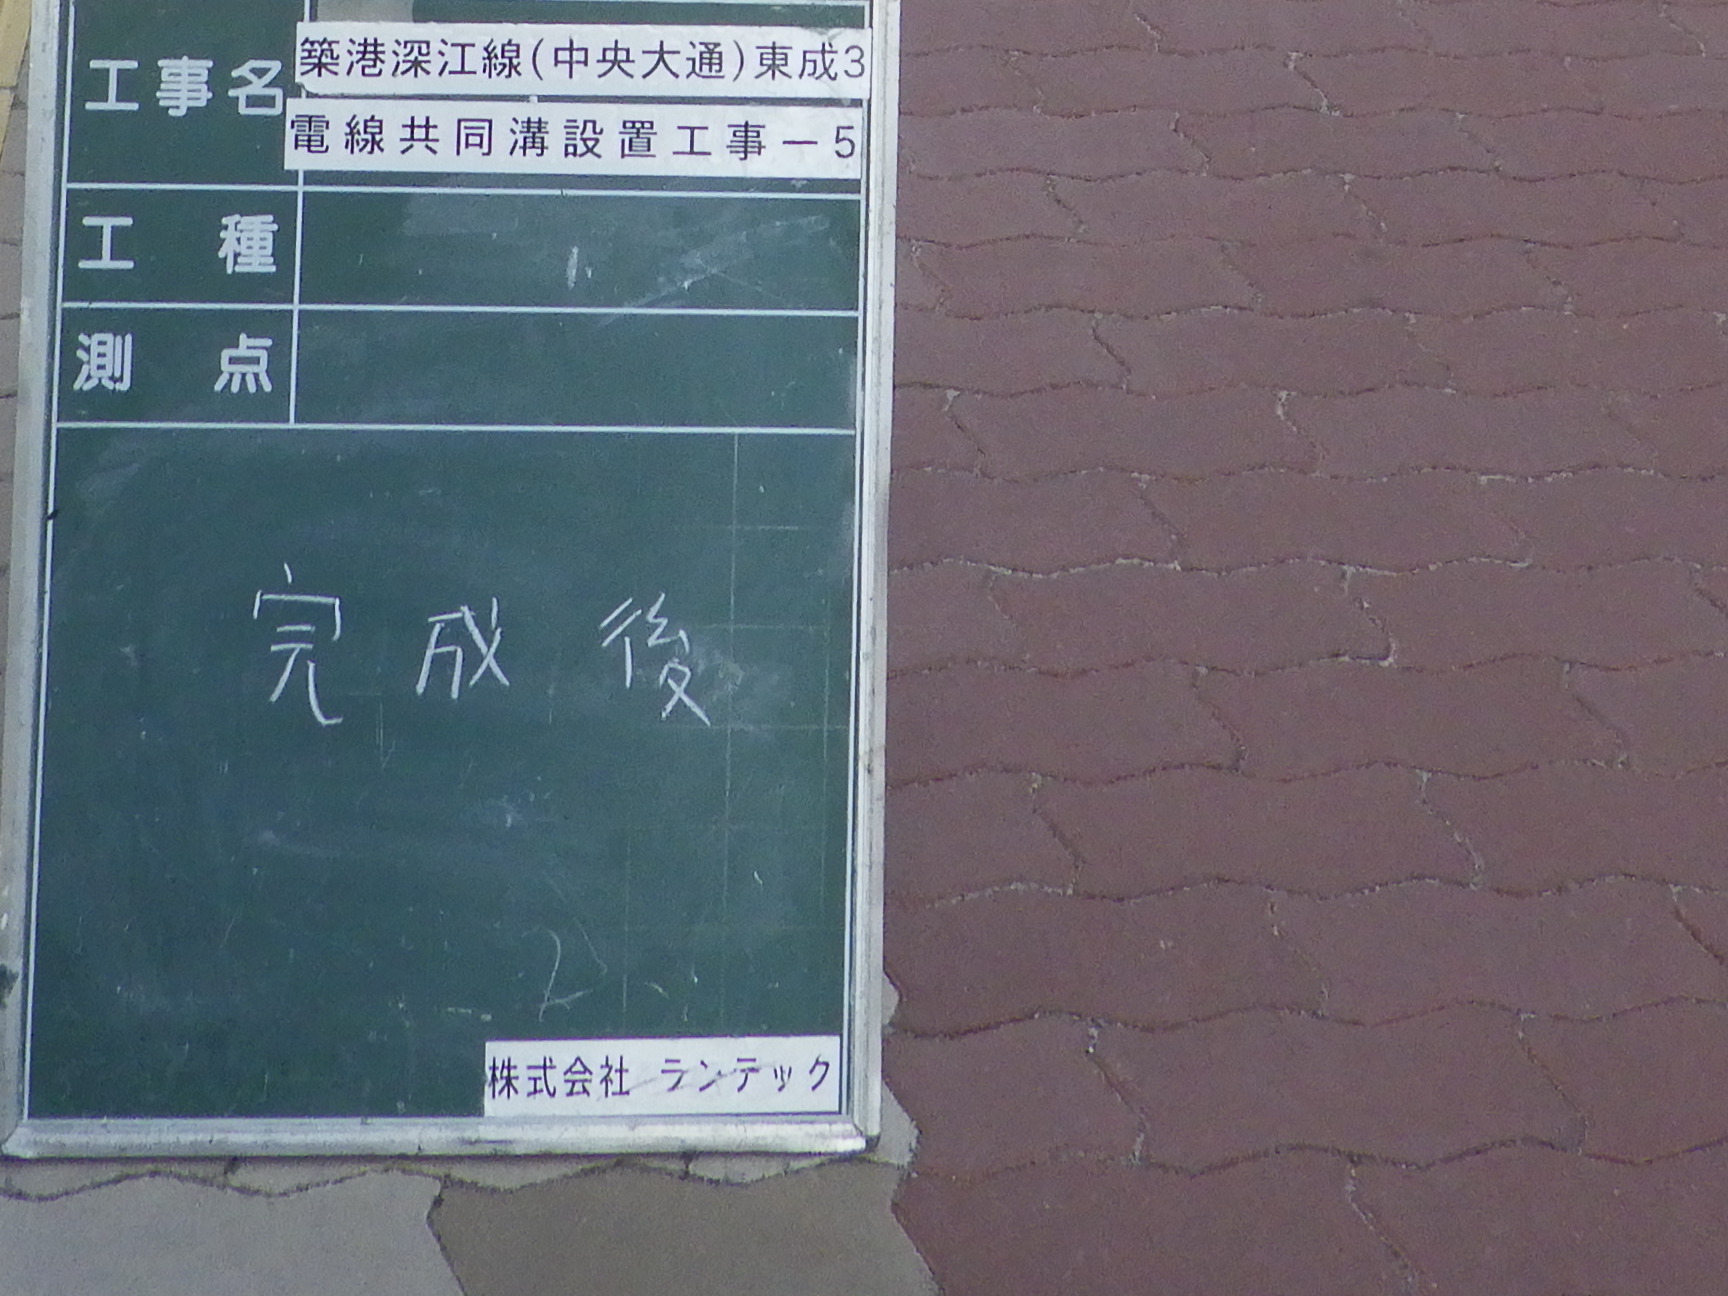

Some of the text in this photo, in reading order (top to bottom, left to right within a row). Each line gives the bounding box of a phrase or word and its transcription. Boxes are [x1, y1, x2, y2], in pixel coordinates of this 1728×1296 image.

[84, 54, 284, 117] 工事名
[487, 1054, 830, 1100] 株式会社 ランテック
